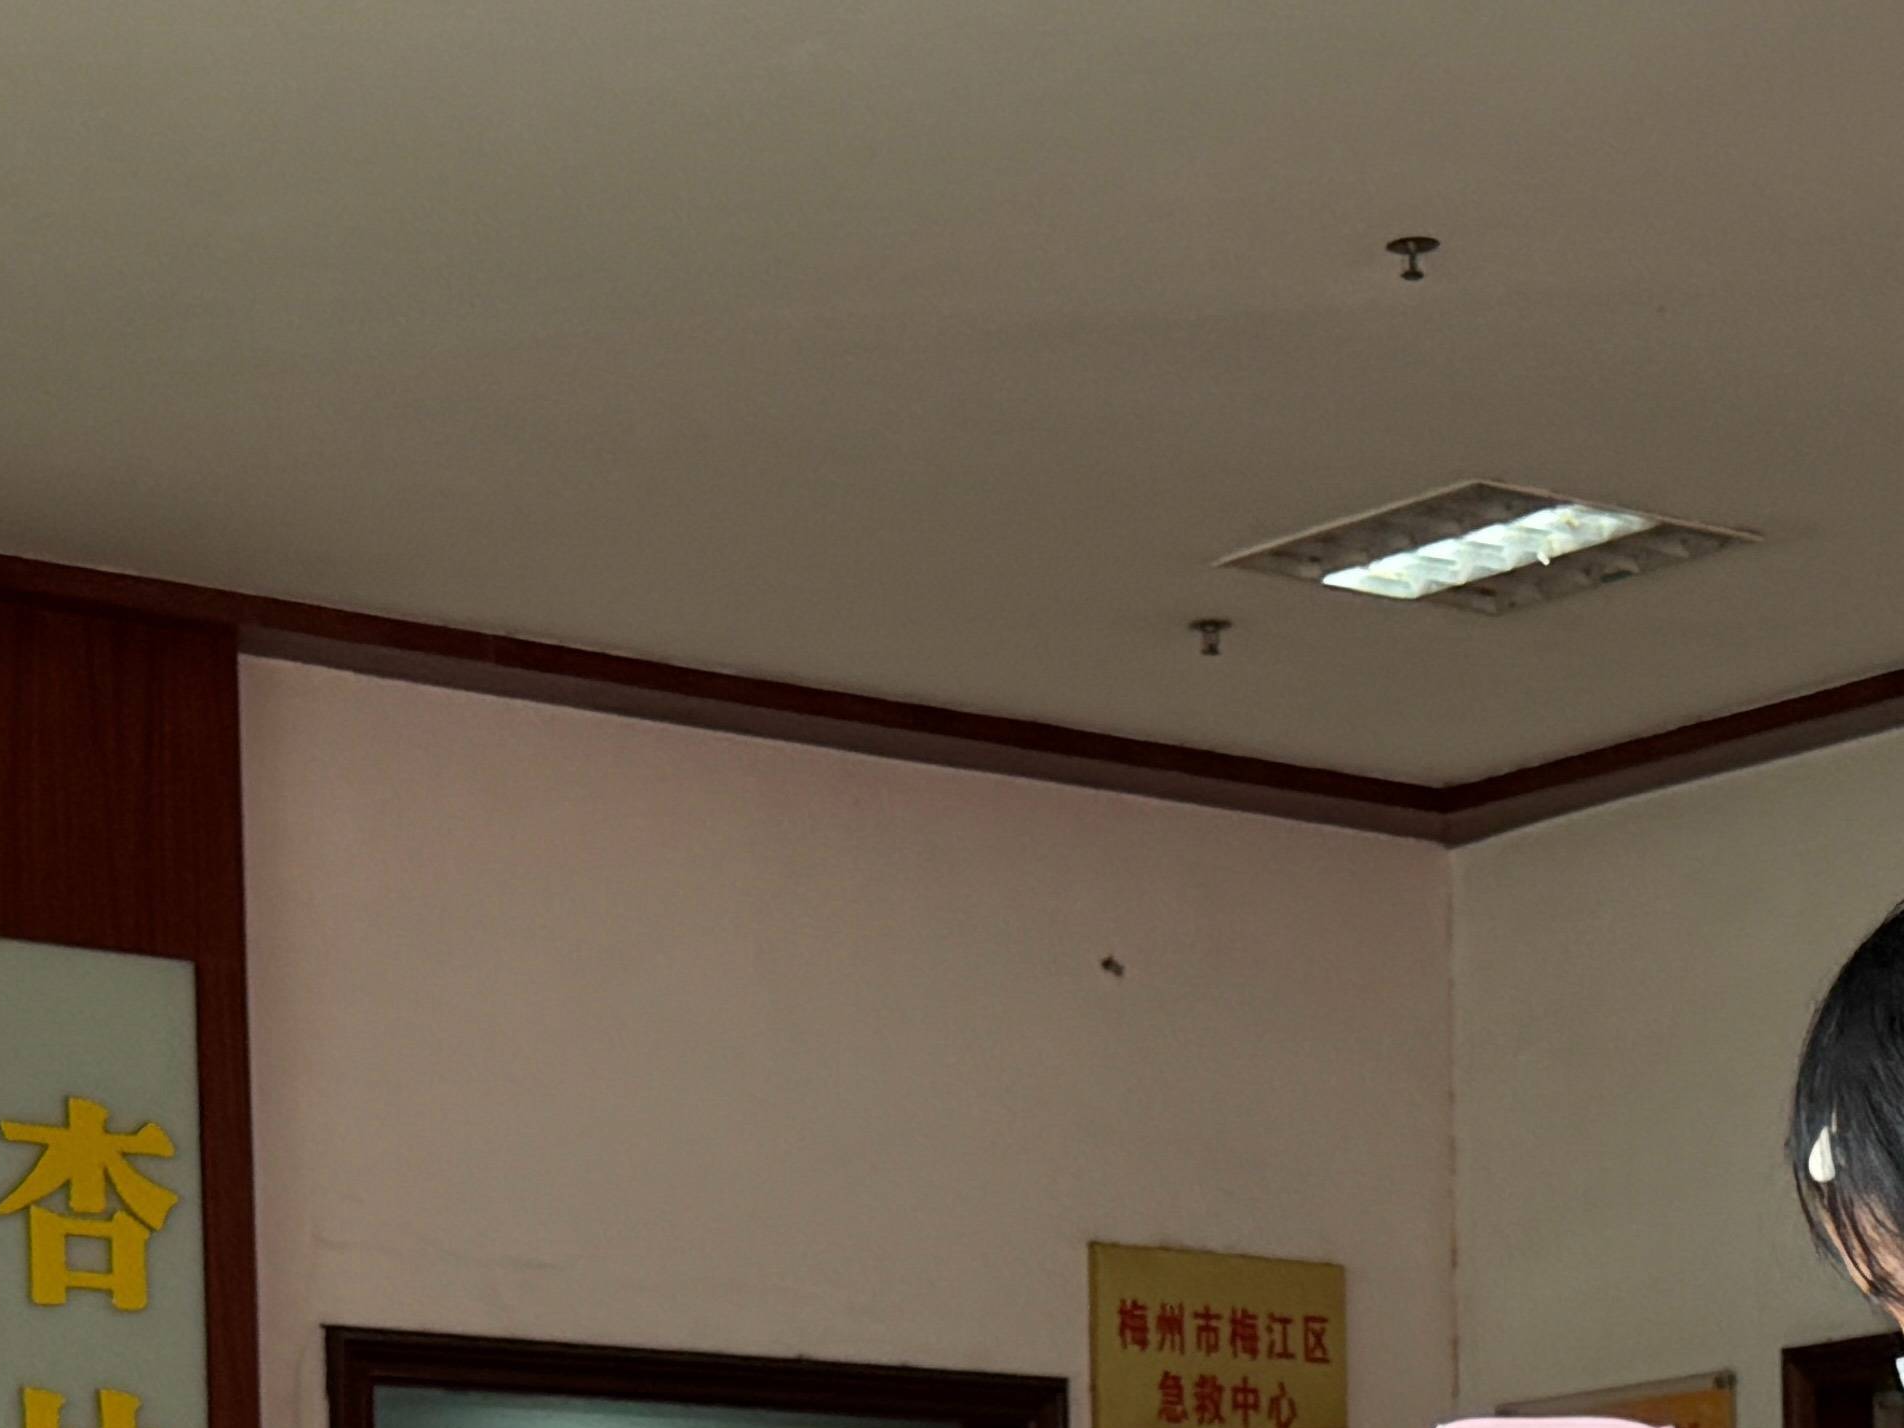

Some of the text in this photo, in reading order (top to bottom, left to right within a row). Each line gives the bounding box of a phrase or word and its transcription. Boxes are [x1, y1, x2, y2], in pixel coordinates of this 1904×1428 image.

[1116, 1297, 1333, 1364] 梅州市梅江区
